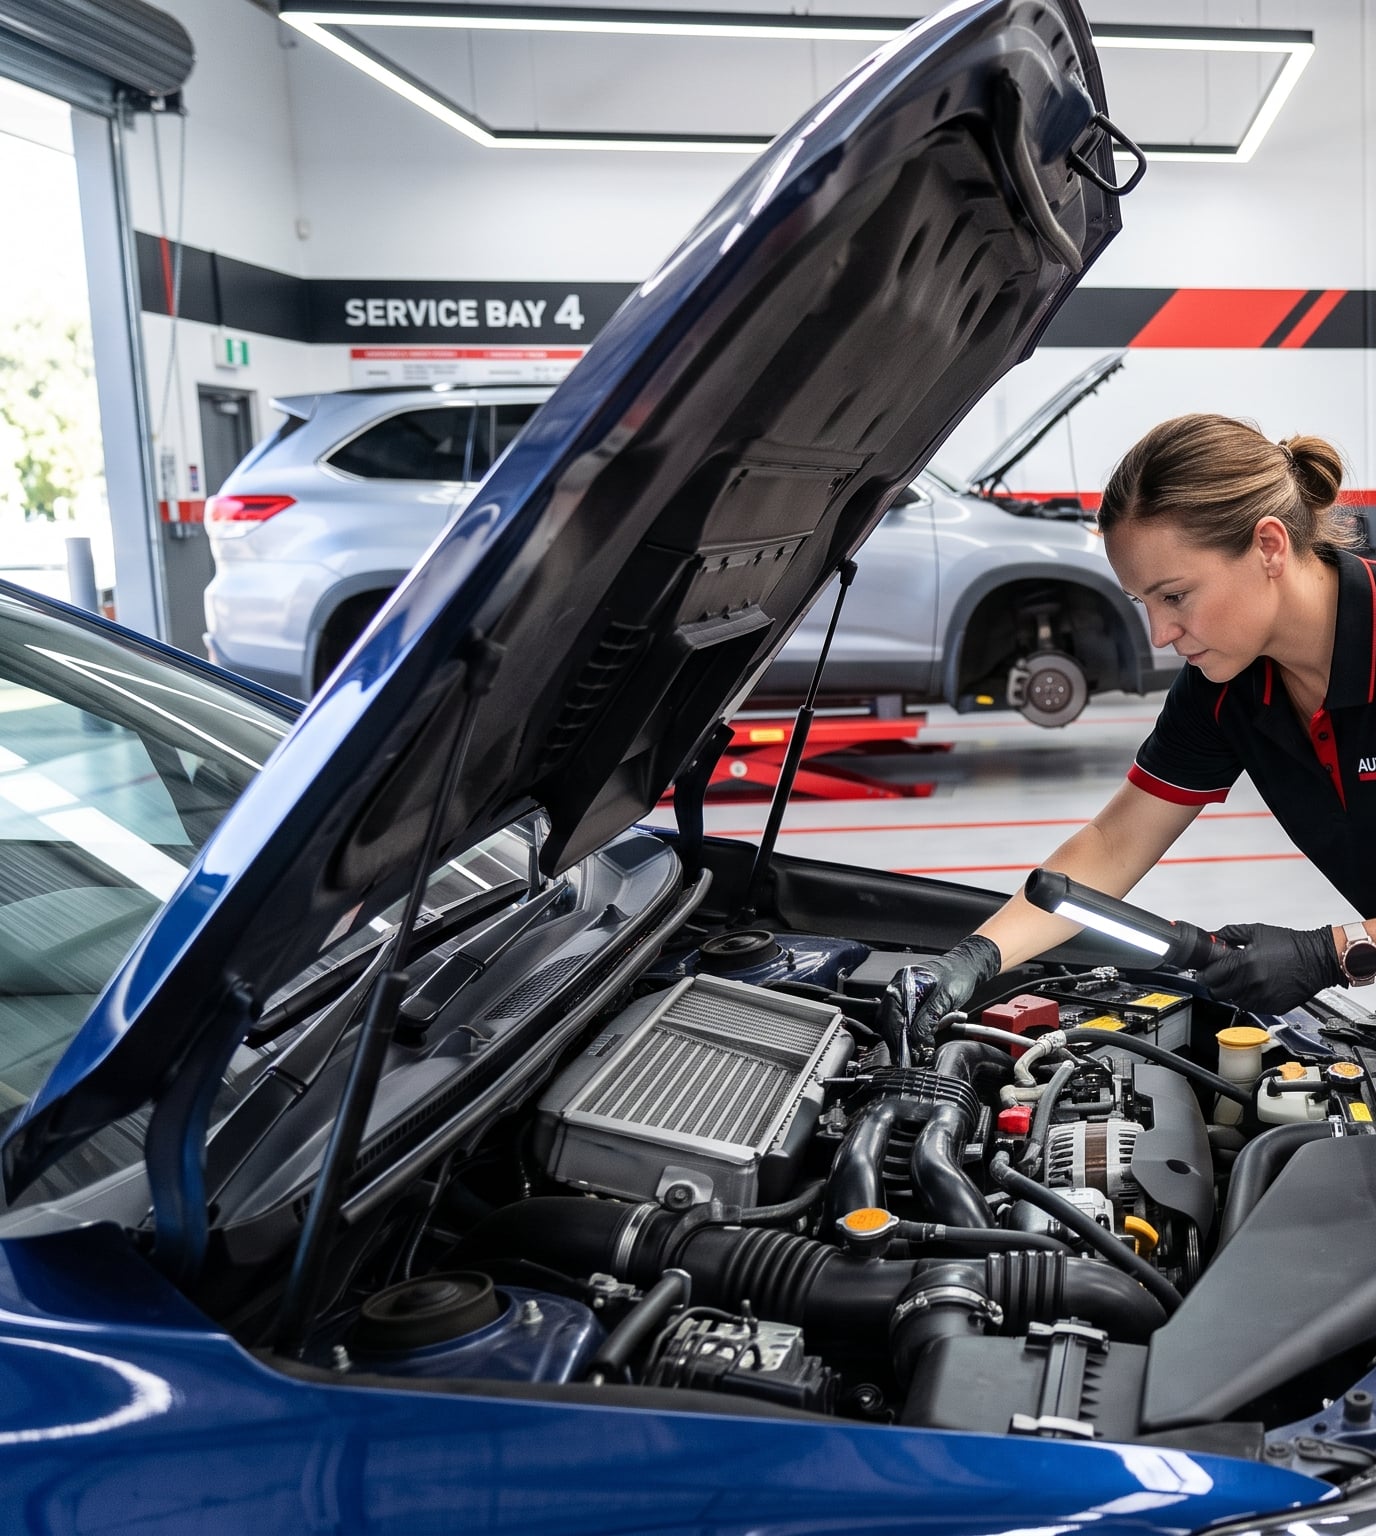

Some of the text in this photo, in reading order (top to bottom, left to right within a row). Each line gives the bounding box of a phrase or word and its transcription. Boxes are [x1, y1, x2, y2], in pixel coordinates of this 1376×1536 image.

[345, 294, 585, 330] SERVICE BAY 4
